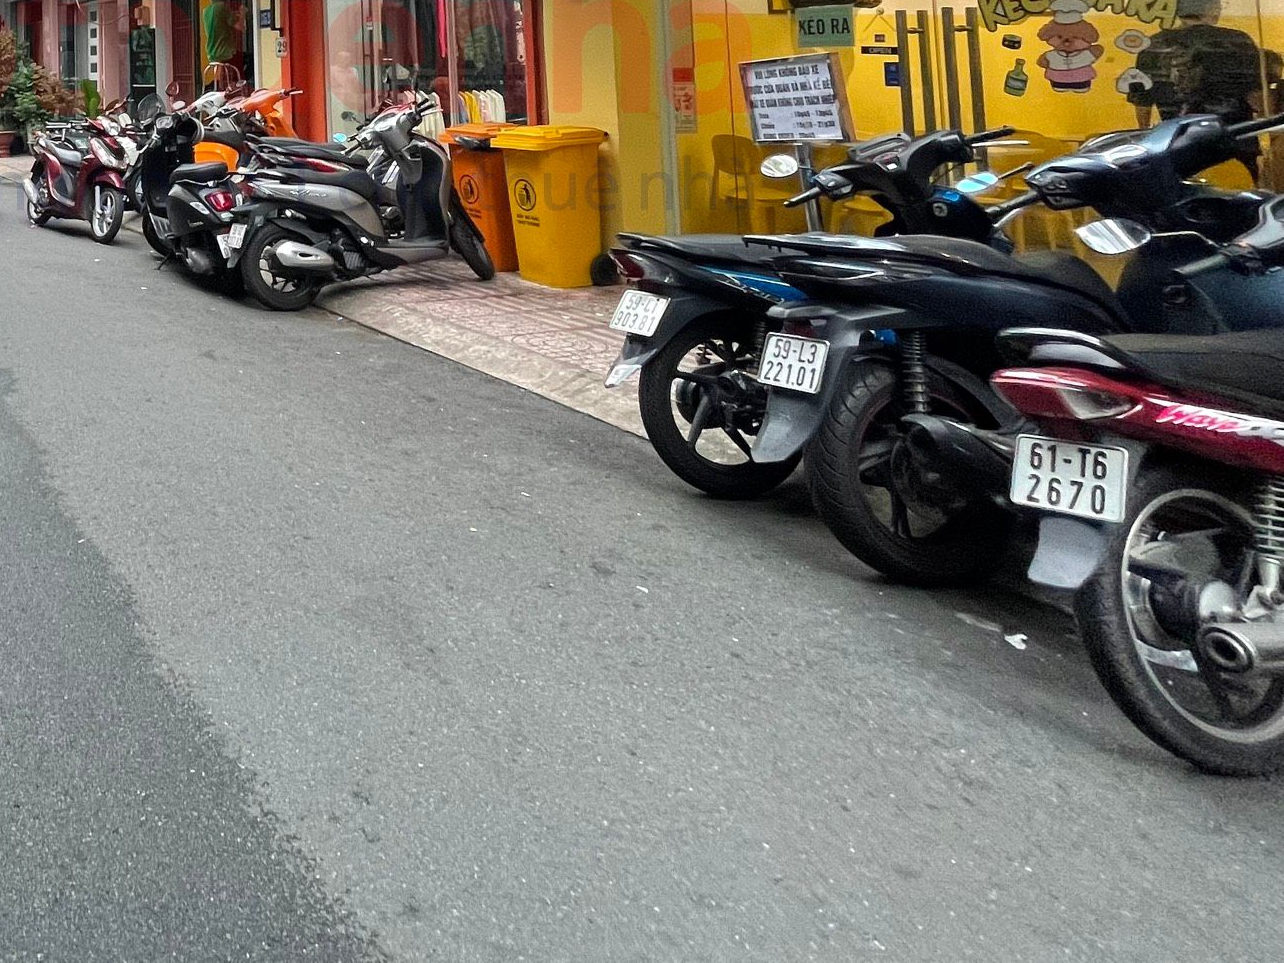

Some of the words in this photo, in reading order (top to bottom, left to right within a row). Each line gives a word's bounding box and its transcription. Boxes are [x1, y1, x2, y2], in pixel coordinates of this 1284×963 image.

[831, 18, 850, 34] RA
[276, 40, 288, 54] 29
[773, 339, 818, 364] 59-L3
[764, 361, 817, 390] 221.01
[1029, 442, 1108, 481] 61-T6
[1025, 474, 1106, 515] 2670
